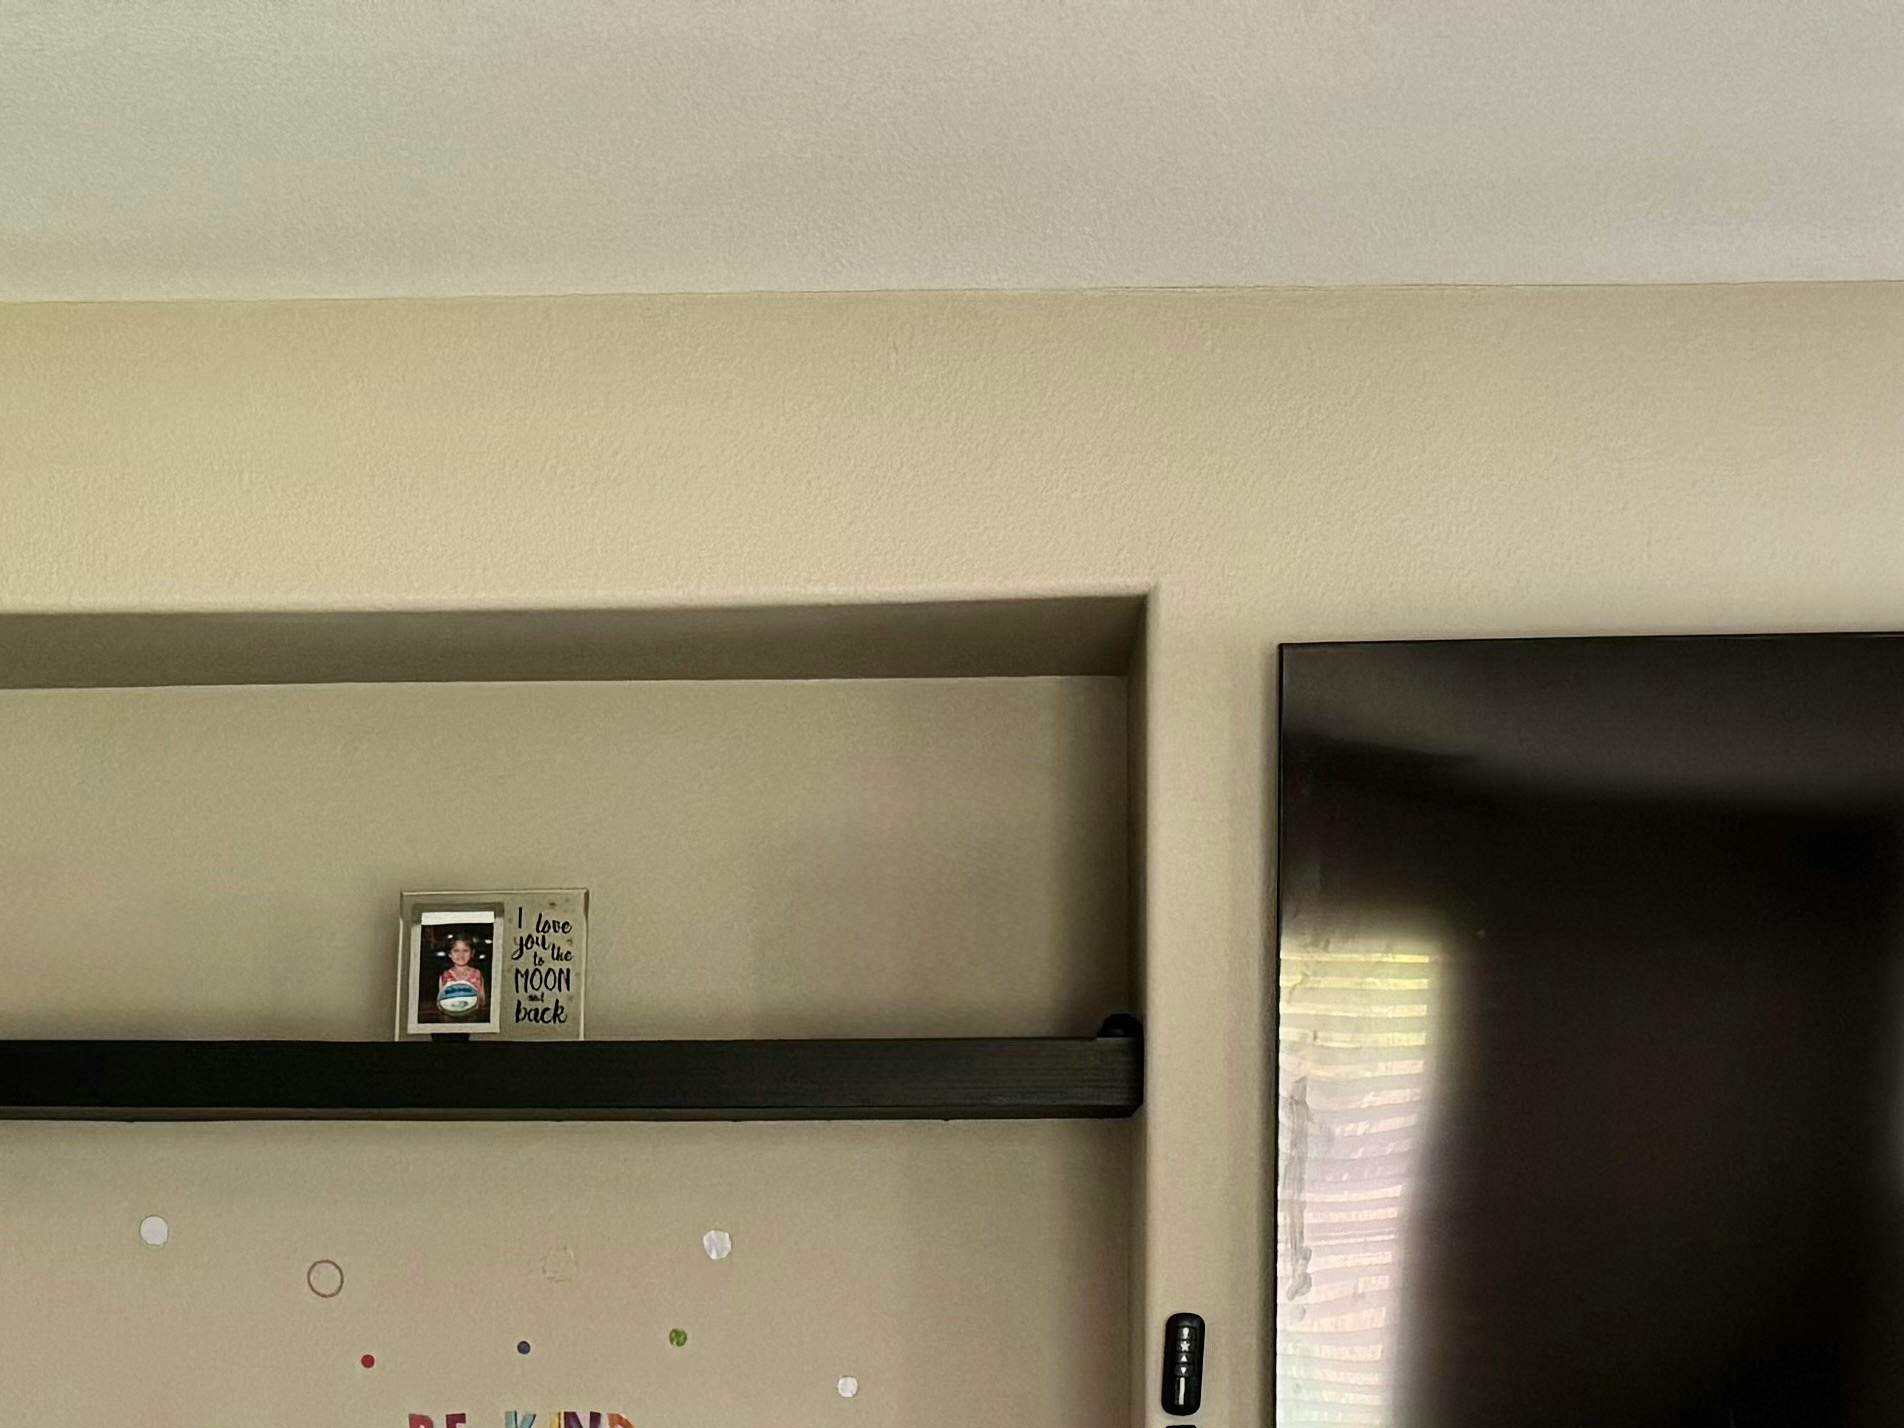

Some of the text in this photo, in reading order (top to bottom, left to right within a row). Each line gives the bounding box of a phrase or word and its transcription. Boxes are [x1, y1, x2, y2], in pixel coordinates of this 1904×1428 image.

[518, 906, 573, 934] I love
[511, 934, 548, 961] you
[533, 942, 574, 967] to the
[514, 967, 571, 994] MOON
[515, 999, 568, 1024] back
